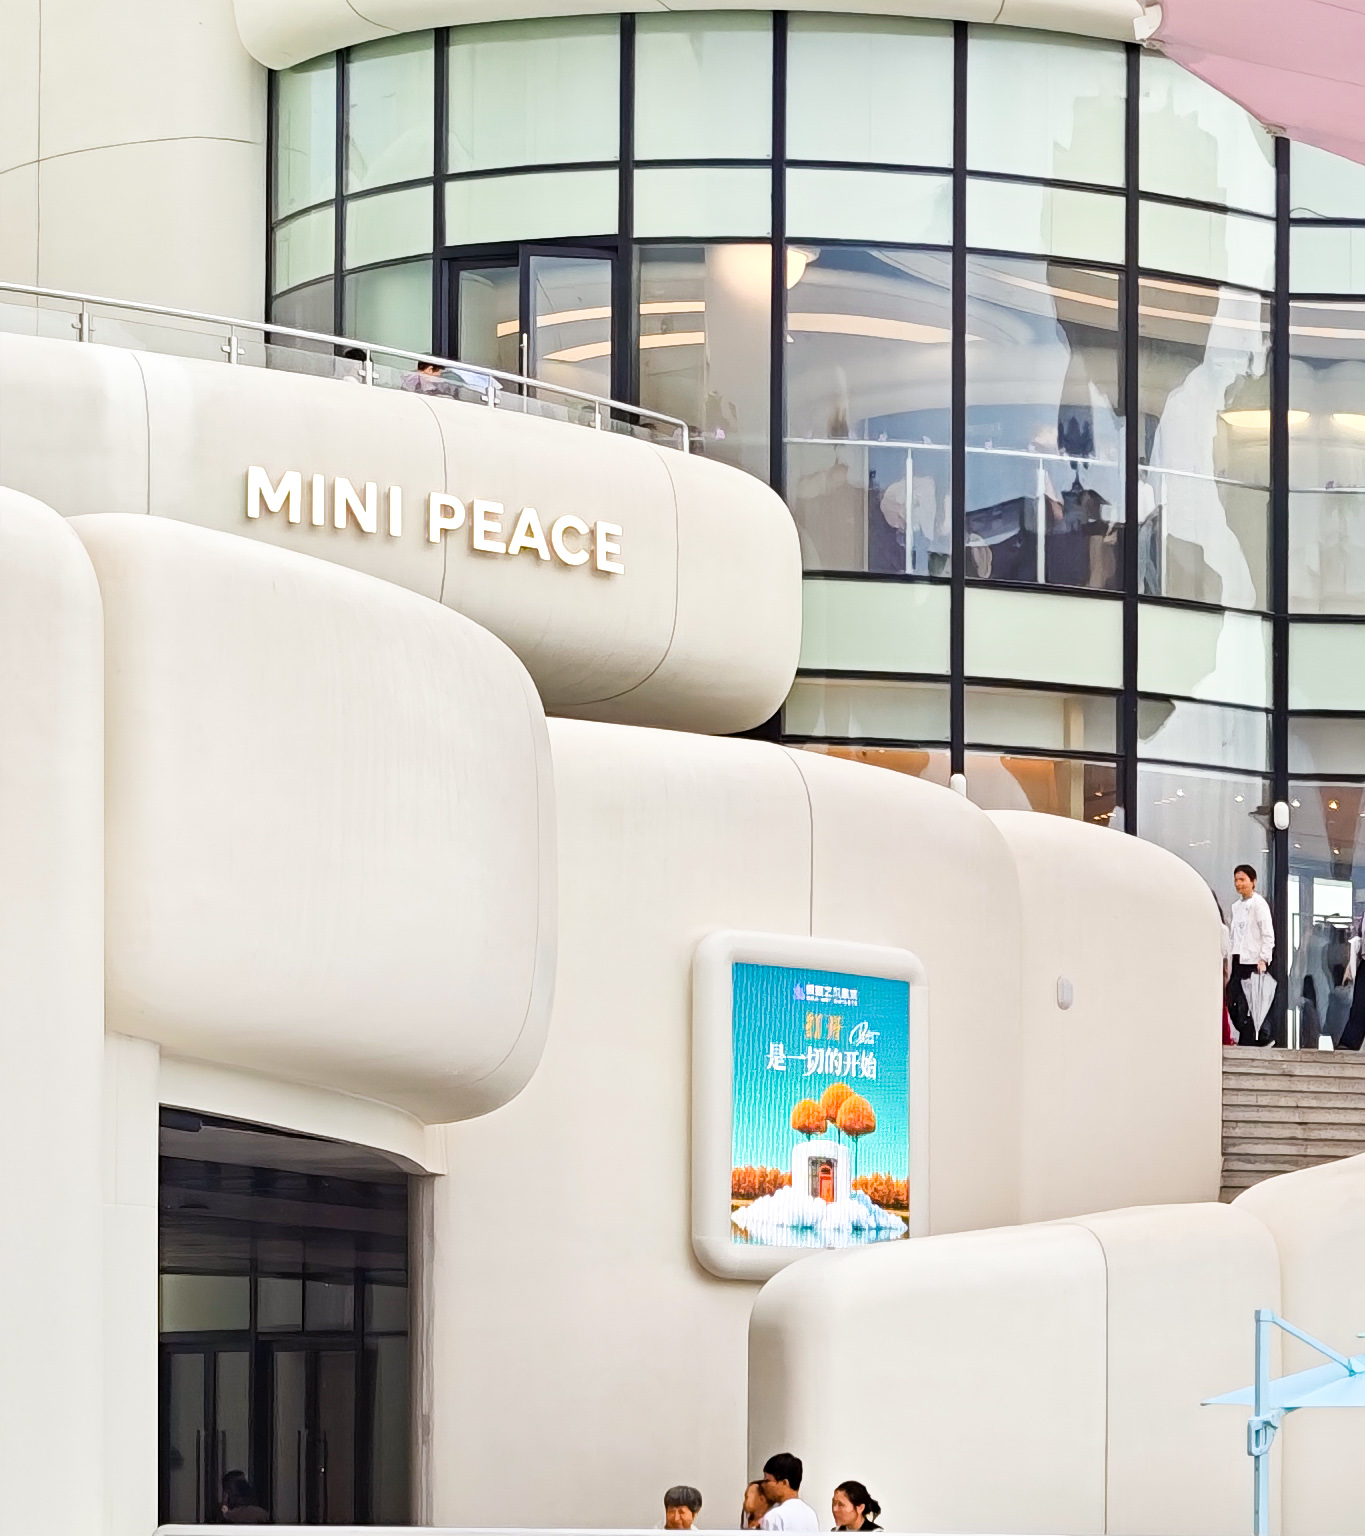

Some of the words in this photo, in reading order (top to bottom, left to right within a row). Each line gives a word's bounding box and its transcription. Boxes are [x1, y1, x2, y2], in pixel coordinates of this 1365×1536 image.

[245, 465, 404, 538] MINI
[427, 491, 625, 576] PEACE
[766, 1041, 877, 1081] 是一切的开始
